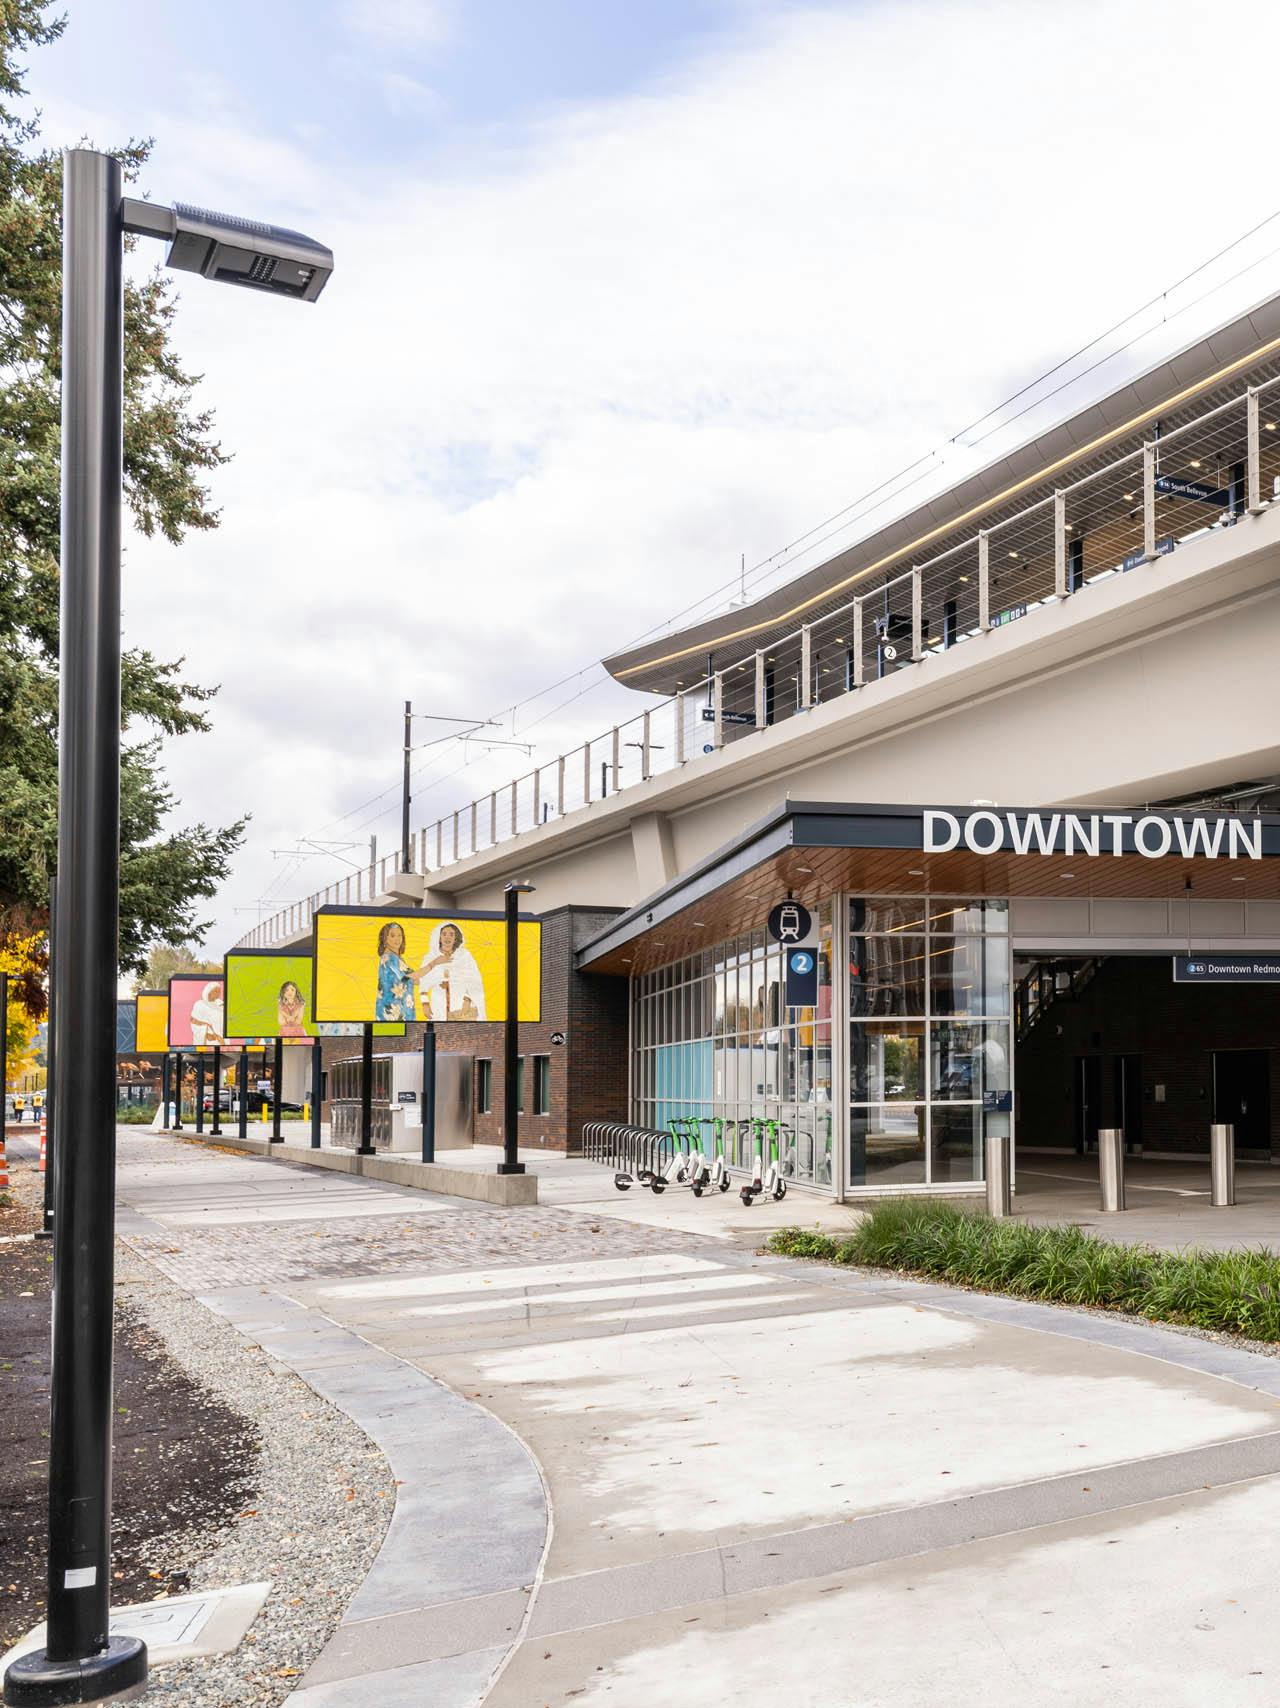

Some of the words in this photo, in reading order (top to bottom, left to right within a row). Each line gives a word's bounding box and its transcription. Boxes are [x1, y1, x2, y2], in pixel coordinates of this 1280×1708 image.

[887, 647, 893, 658] 2
[923, 810, 1262, 860] DOWNTOWN
[796, 955, 807, 971] 2
[1208, 964, 1251, 974] Downtown
